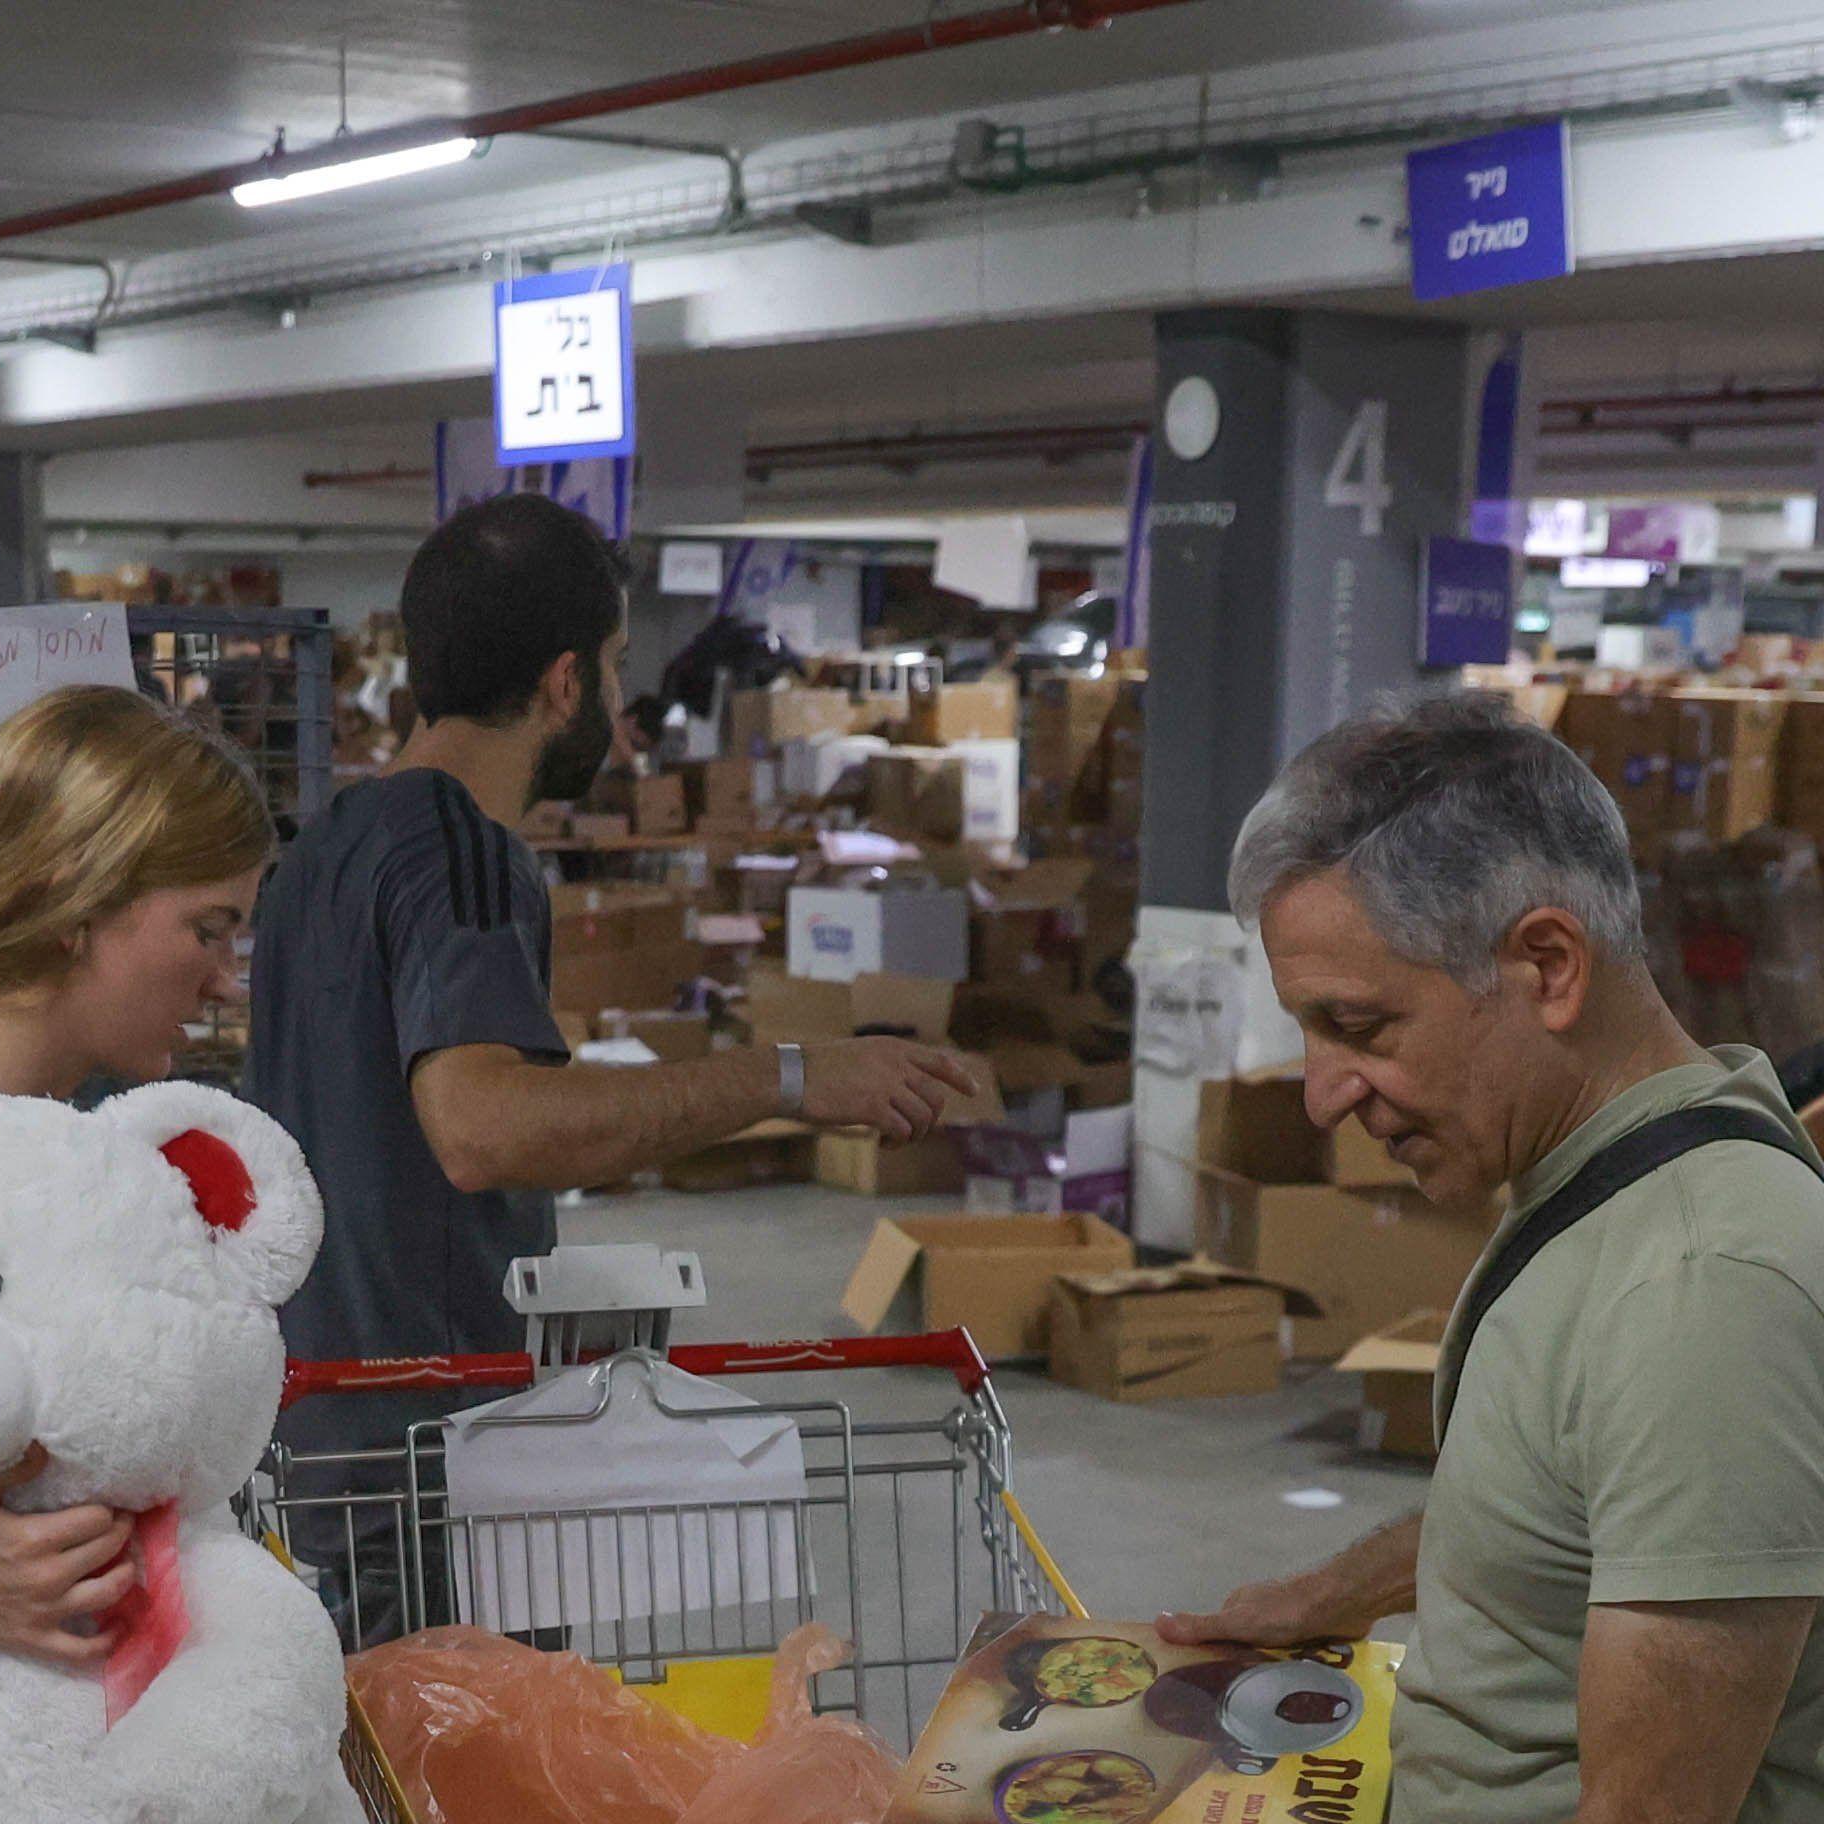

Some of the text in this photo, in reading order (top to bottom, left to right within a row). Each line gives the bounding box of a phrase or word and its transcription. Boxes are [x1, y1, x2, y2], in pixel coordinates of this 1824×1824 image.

[545, 307, 594, 353] כלי
[526, 372, 605, 417] בית
[1325, 400, 1395, 536] 4
